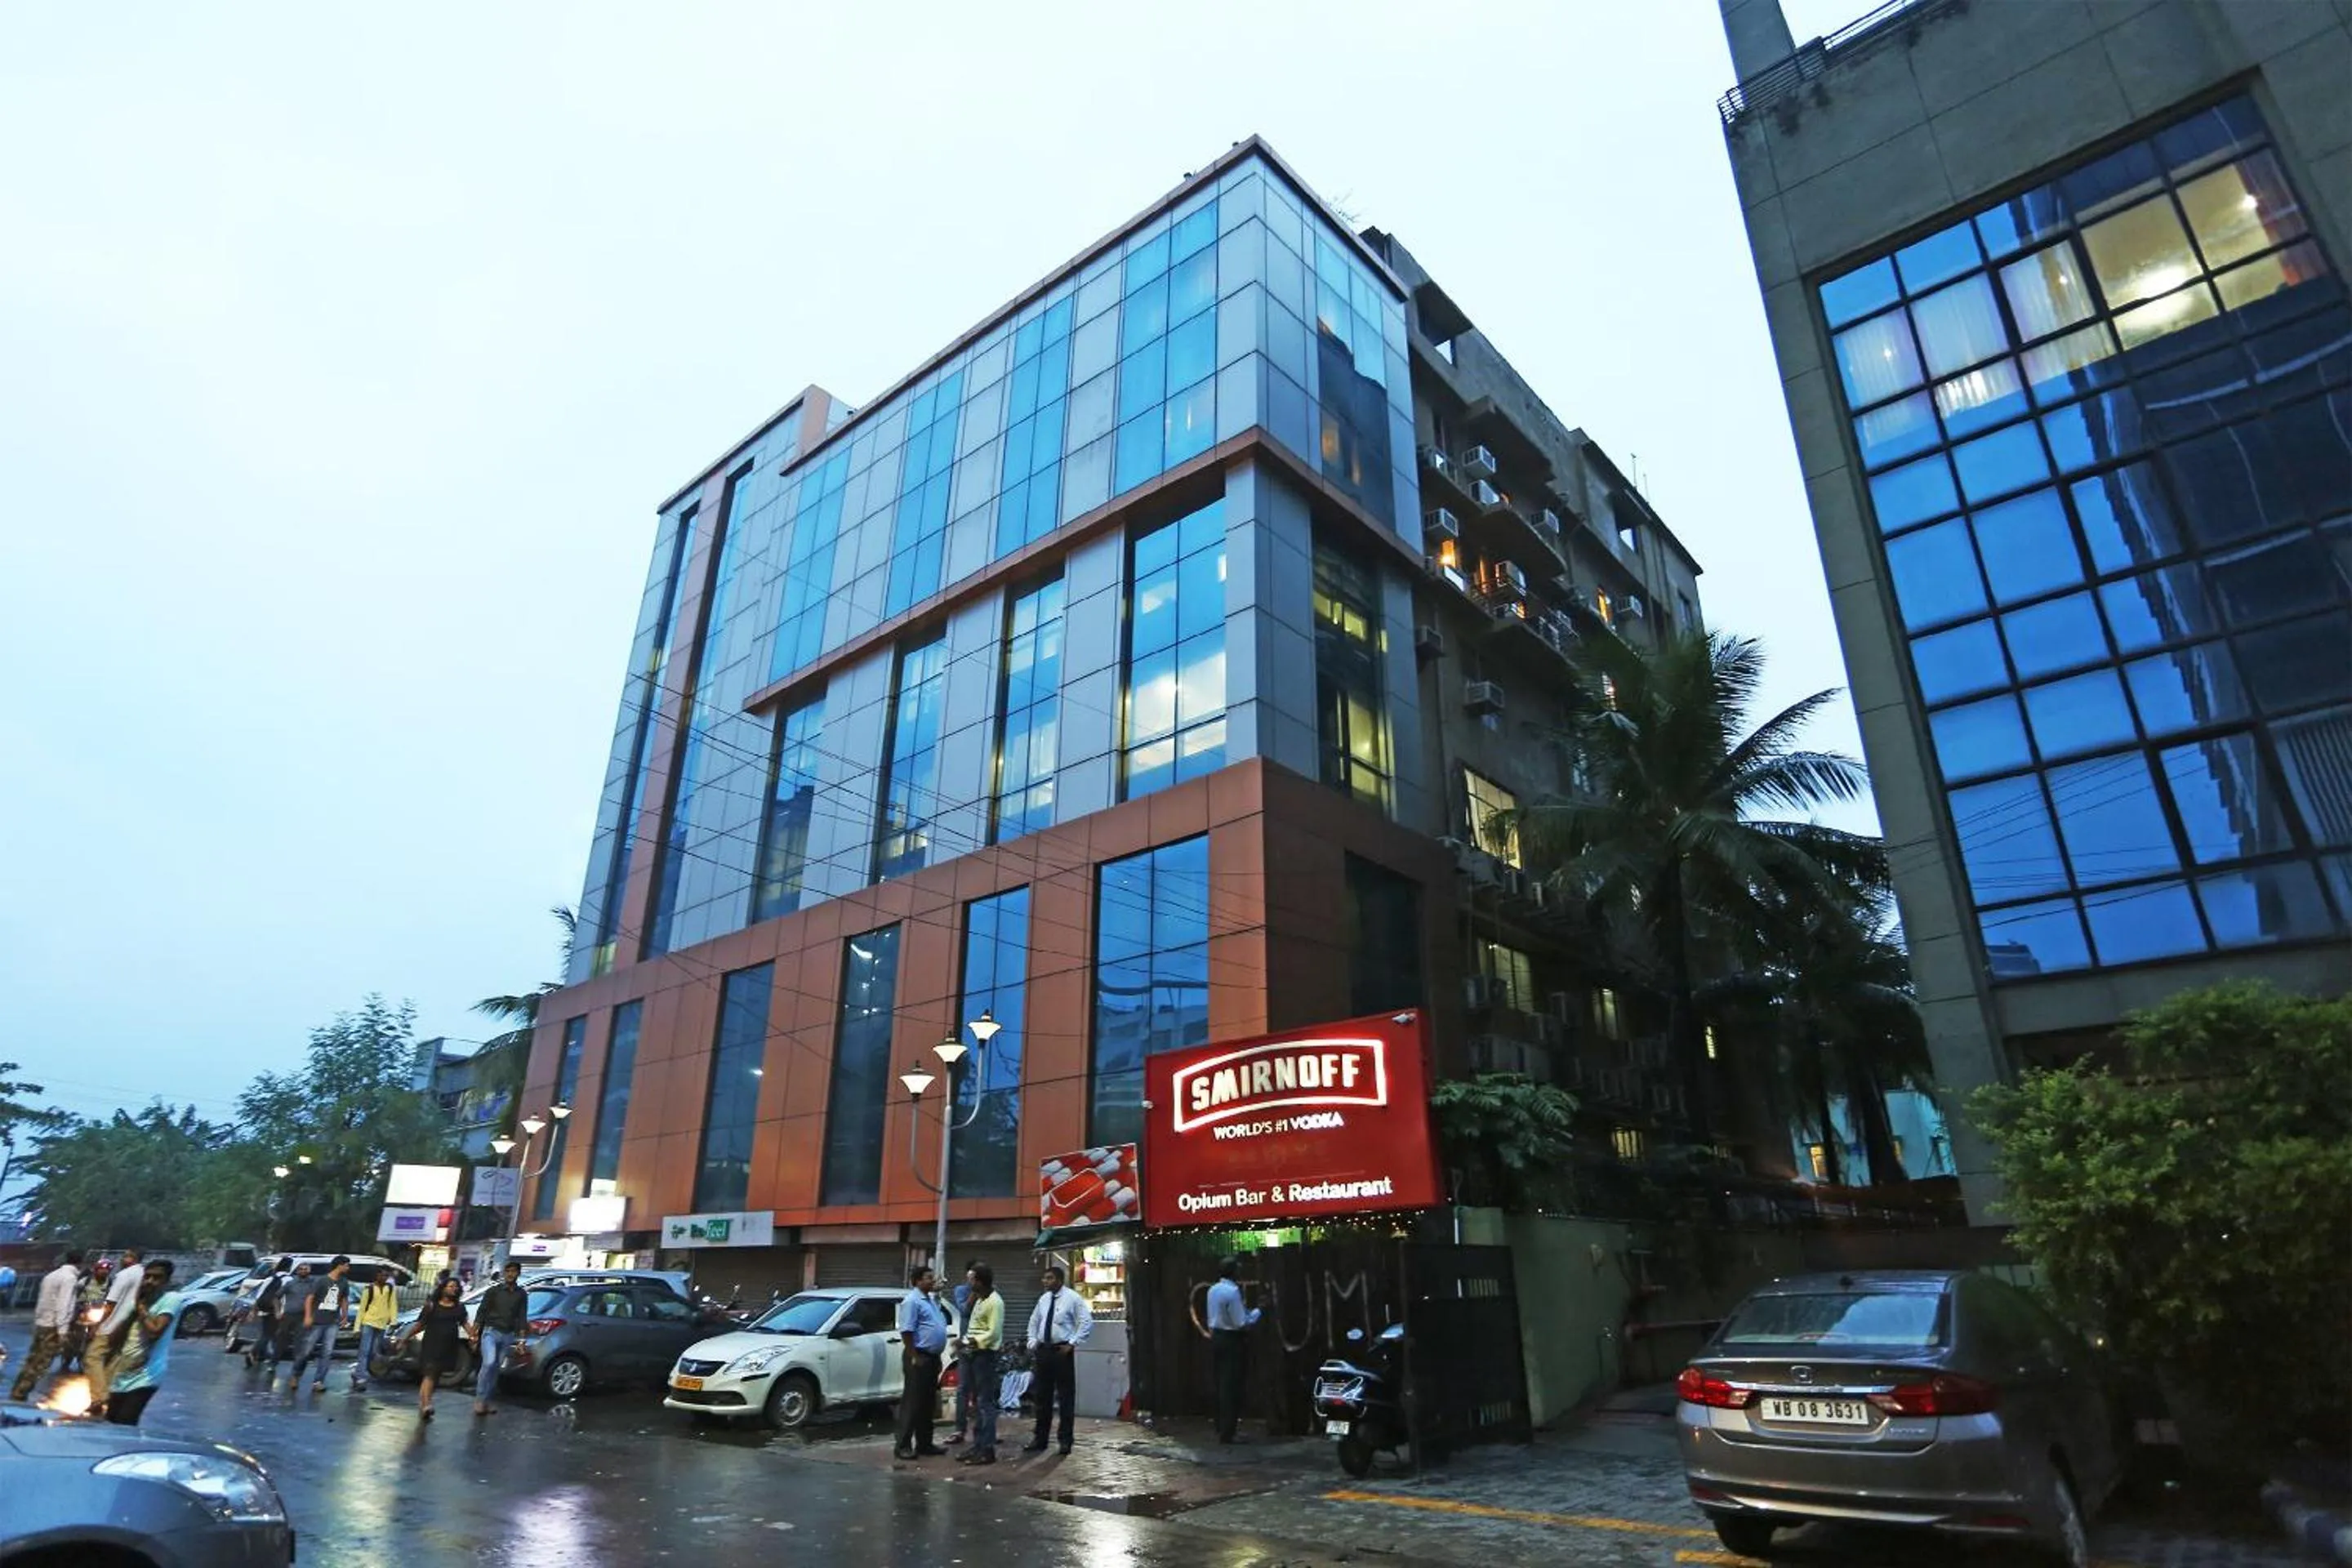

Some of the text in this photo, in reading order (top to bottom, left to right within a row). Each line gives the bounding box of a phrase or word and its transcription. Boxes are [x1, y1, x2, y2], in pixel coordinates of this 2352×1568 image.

[1191, 1054, 1361, 1111] SMIRNOFF
[1213, 1111, 1344, 1140] WORLD'S #1 VODKA
[1178, 1176, 1393, 1214] Opium Bar & Restaurant
[1773, 1401, 1791, 1416] WB
